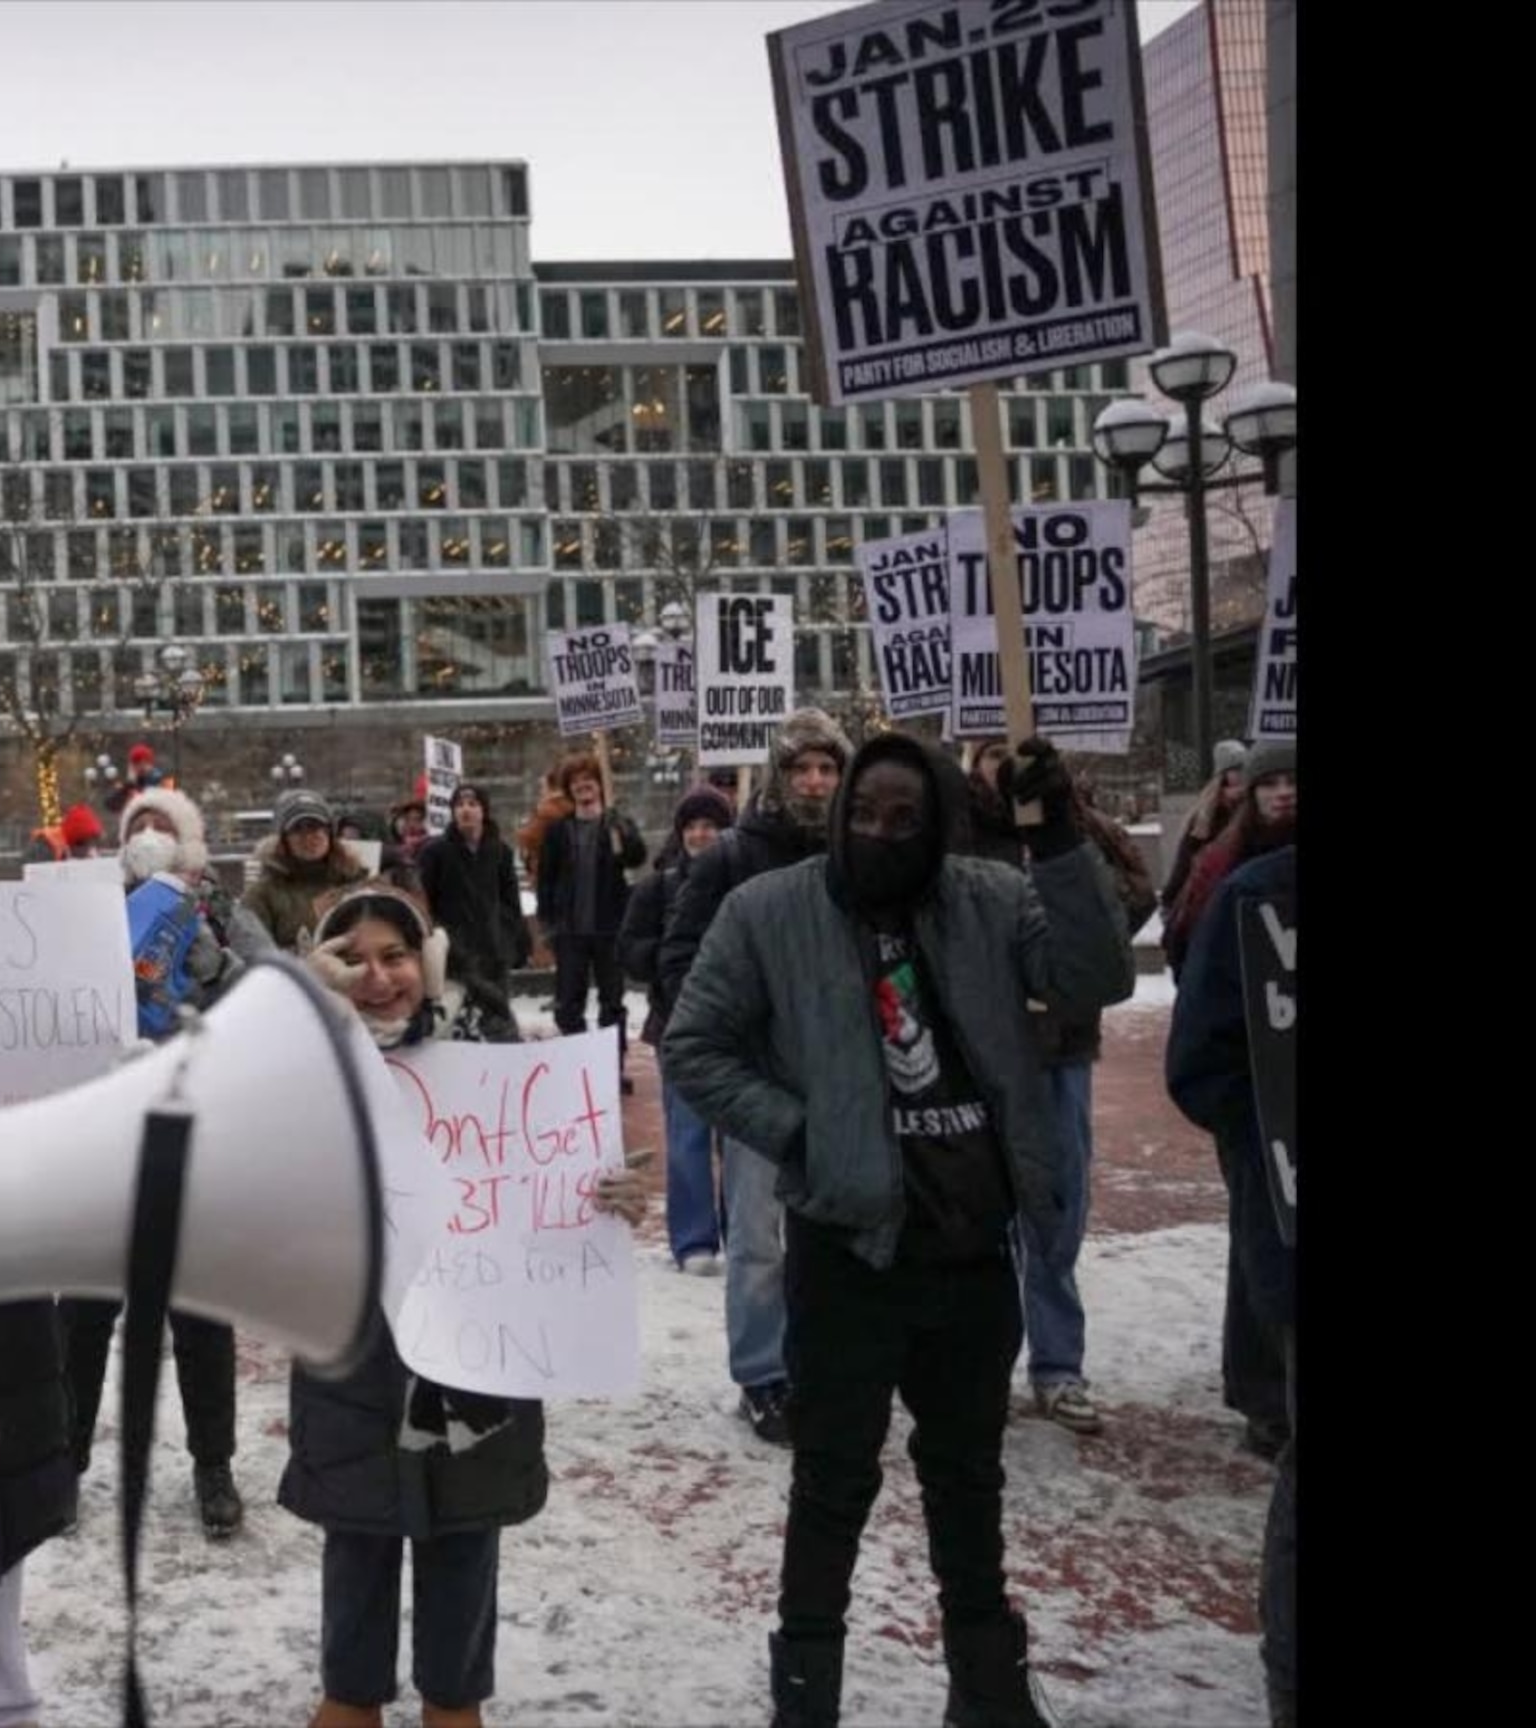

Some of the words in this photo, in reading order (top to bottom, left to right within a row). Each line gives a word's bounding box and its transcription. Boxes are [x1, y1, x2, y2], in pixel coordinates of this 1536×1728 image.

[811, 18, 1114, 203] STRIKE
[840, 167, 1104, 247] AGAINST
[825, 182, 1133, 351] RACISM
[843, 360, 892, 389] PARTY
[893, 354, 926, 380] FOR
[926, 336, 1013, 372] SOCIALISM
[1014, 333, 1037, 356] &
[1037, 312, 1136, 352] LIBERATION
[1013, 513, 1089, 550] NO
[957, 547, 1126, 617] TOOPS
[553, 644, 632, 684] TROOPS
[567, 632, 610, 653] NO
[718, 597, 776, 675] ICE
[1024, 625, 1064, 648] IN
[560, 686, 637, 718] MINNESOTA
[705, 686, 736, 716] OUT
[737, 686, 756, 715] OF
[757, 686, 786, 714] OUR
[961, 647, 1128, 697] MIESOTA
[0, 984, 124, 1054] STOLEN
[520, 1060, 610, 1166] Get
